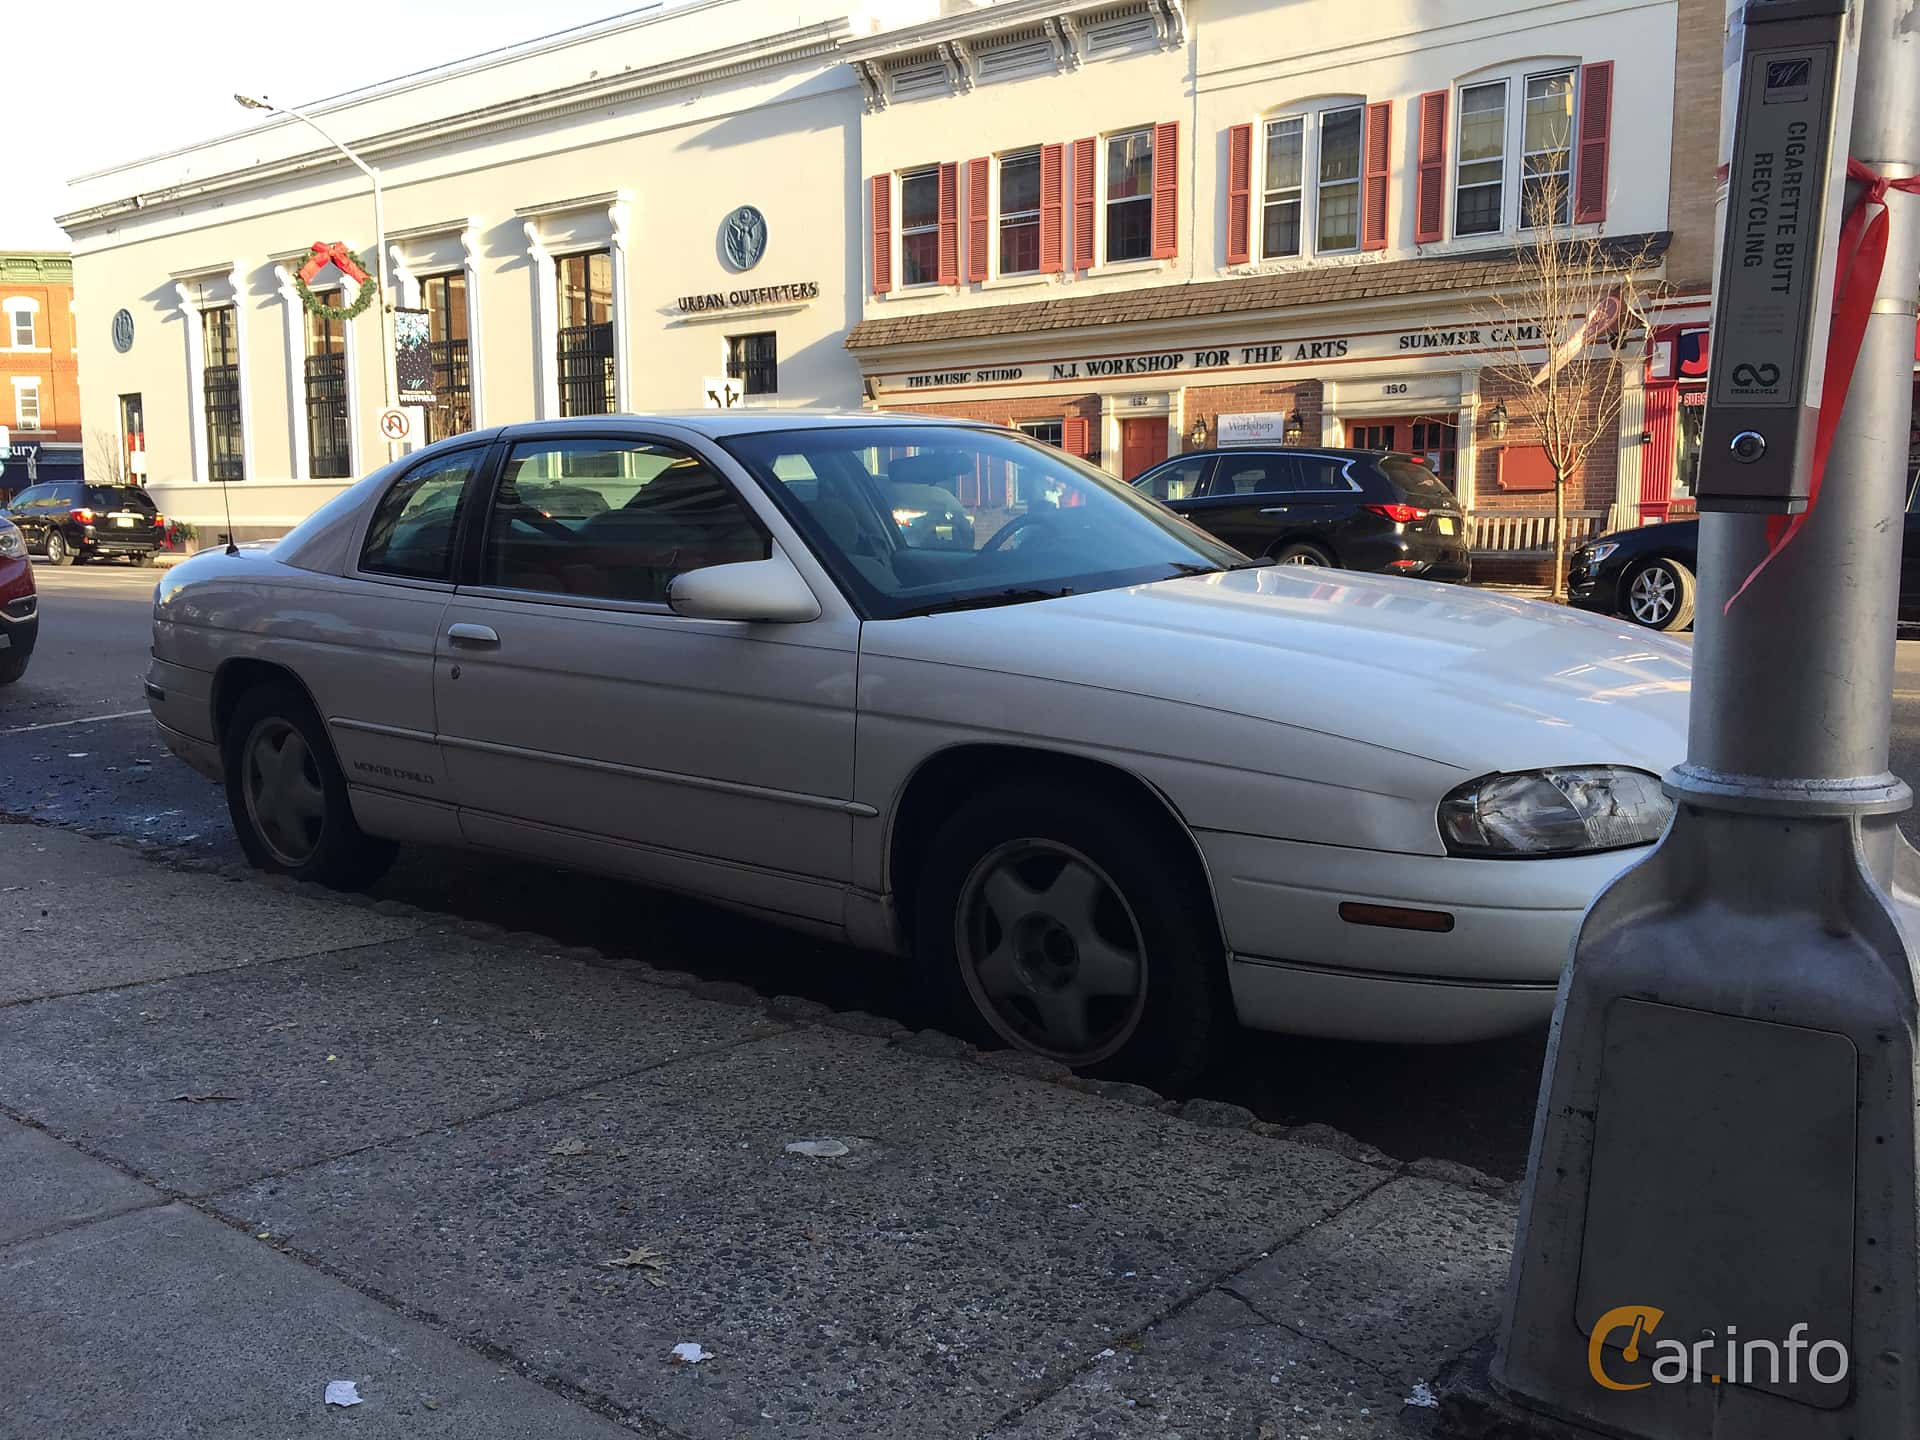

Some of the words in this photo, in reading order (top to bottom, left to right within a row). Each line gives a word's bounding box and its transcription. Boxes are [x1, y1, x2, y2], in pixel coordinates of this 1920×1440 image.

[1777, 121, 1808, 236] CIGARETTE
[1743, 152, 1774, 268] RECYCLING
[1770, 242, 1795, 295] BUTT
[678, 293, 725, 312] URBAN
[729, 281, 819, 306] OUTFITTERS
[1399, 330, 1480, 350] SUMMER
[1053, 363, 1080, 380] N.J.
[1086, 353, 1184, 376] WORKSHOP
[1195, 350, 1231, 368] FOR
[1241, 345, 1282, 364] THE
[1295, 339, 1348, 361] ARTS
[908, 376, 932, 388] THE
[933, 372, 972, 386] MUSIC
[976, 368, 1023, 382] STUDIO
[1385, 383, 1407, 394] 150
